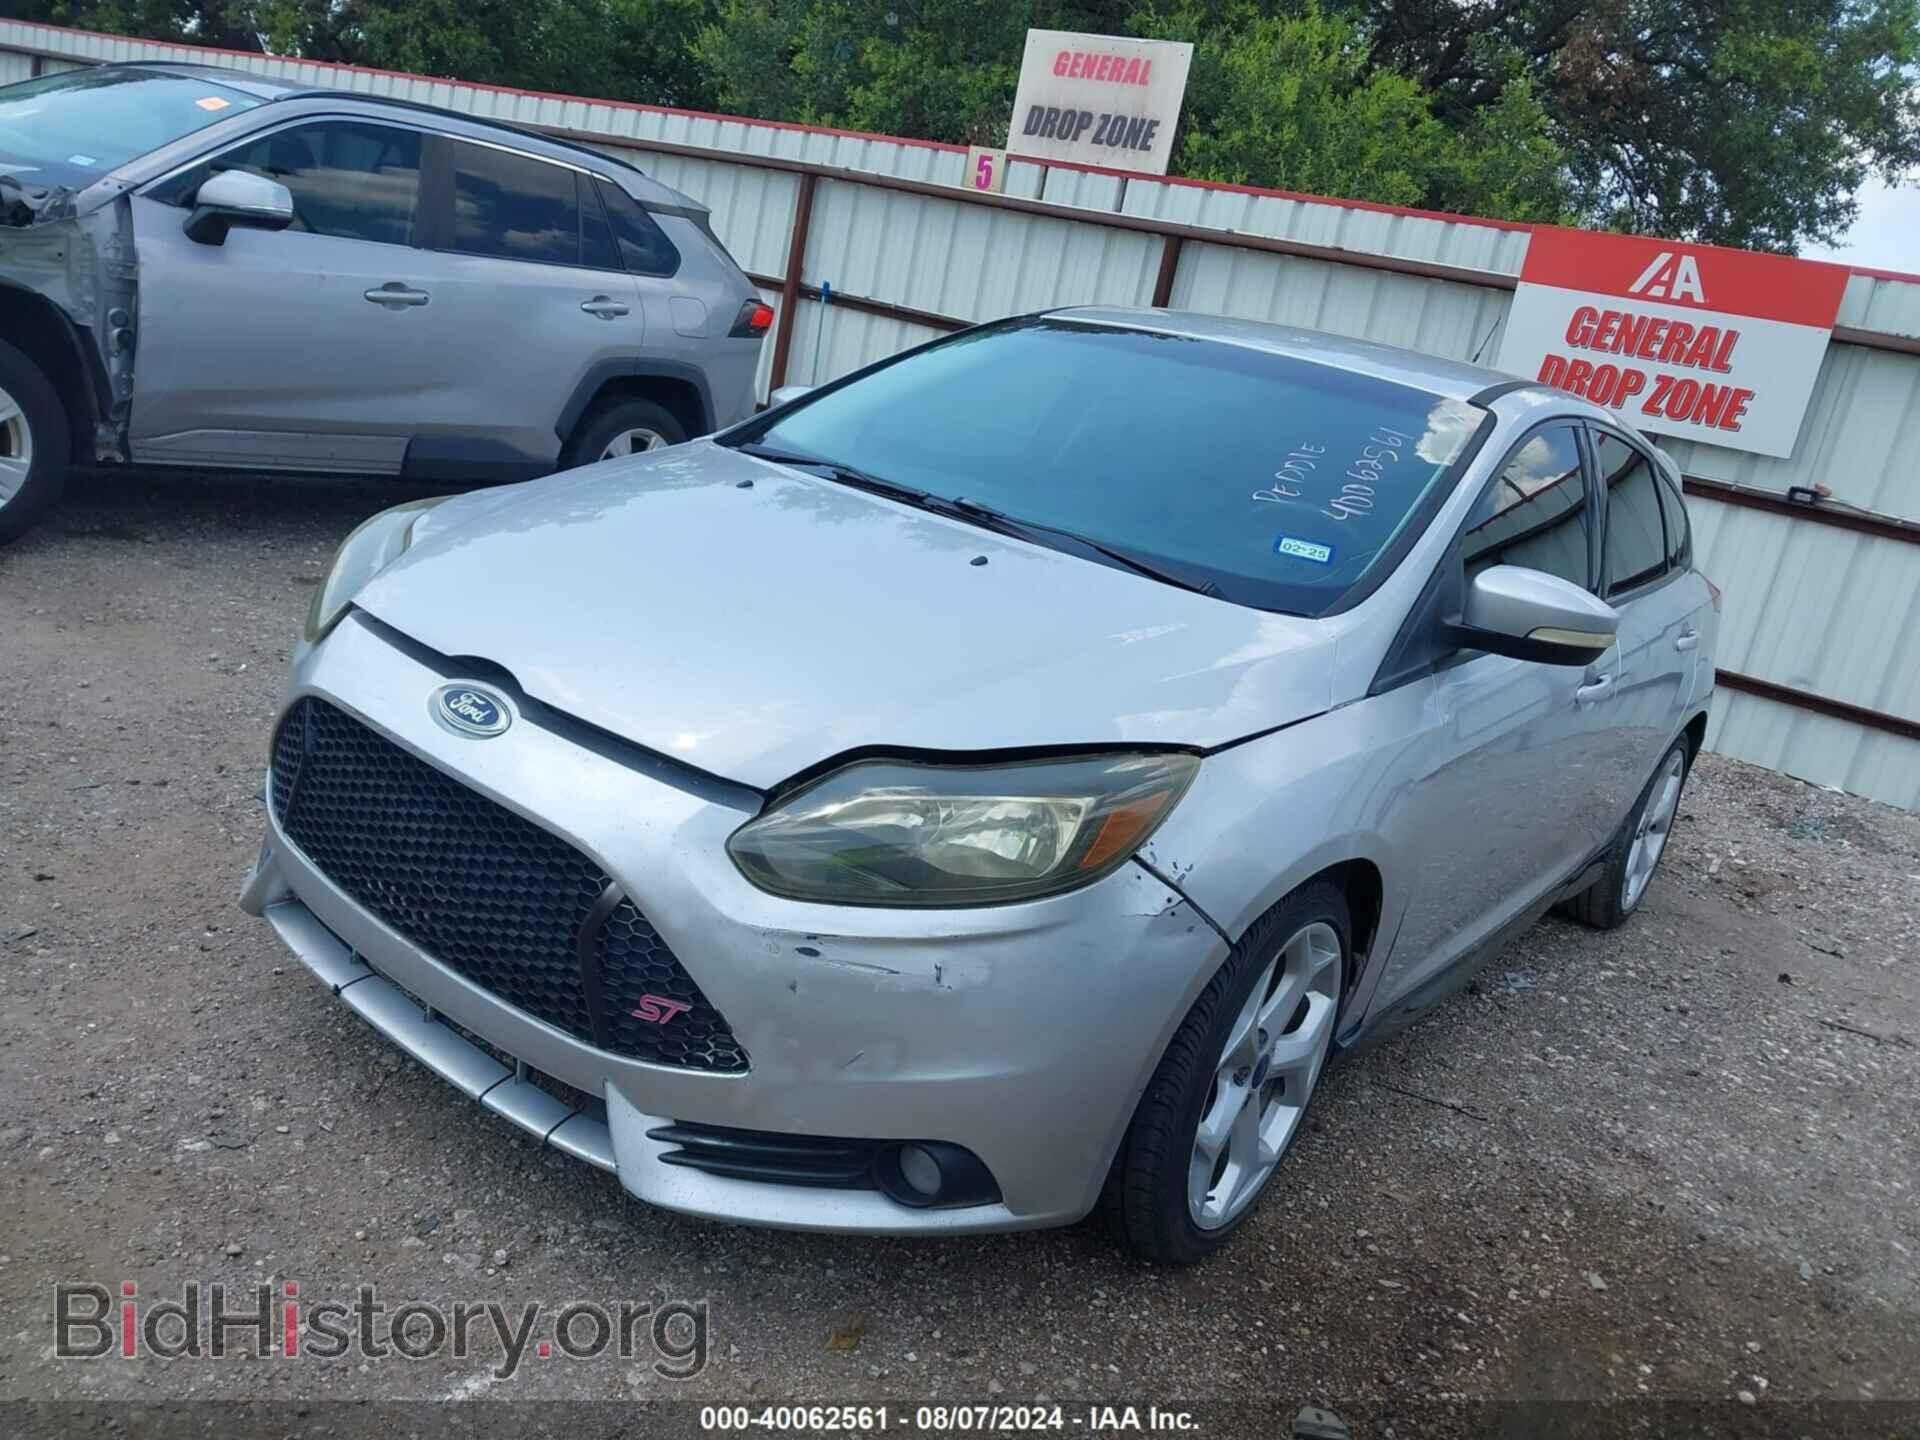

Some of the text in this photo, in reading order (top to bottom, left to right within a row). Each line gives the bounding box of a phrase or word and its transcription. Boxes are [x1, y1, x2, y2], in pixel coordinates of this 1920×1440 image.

[1053, 51, 1152, 87] GENERAL
[1022, 105, 1161, 151] DROP ZONE
[975, 154, 993, 190] 5
[1565, 306, 1740, 374] GENERAL
[1536, 353, 1755, 433] DROP ZONE
[1320, 426, 1417, 521] 40062561
[1282, 542, 1327, 559] 02-25
[449, 692, 492, 723] Ford
[631, 993, 693, 1025] ST
